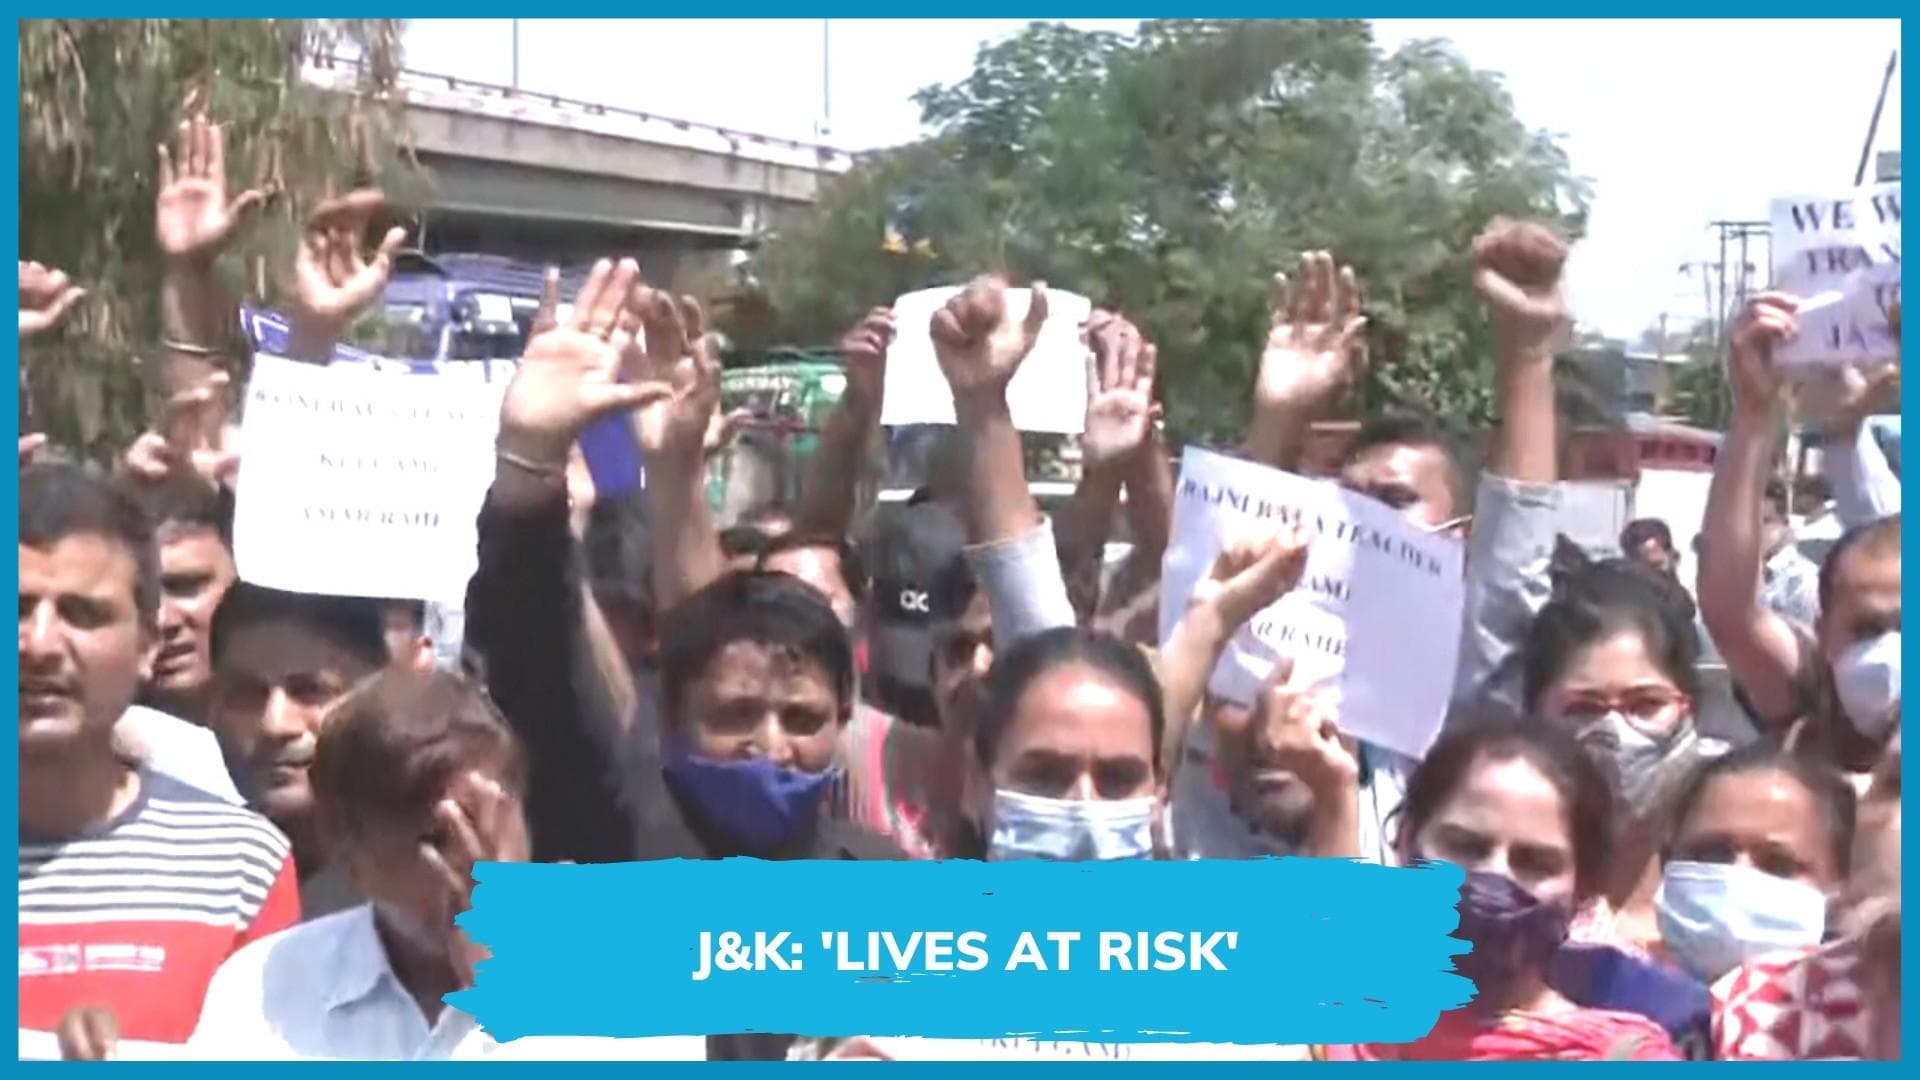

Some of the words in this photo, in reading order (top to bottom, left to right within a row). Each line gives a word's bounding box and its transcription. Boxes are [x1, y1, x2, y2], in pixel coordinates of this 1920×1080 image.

[1791, 200, 1855, 233] WE
[1180, 478, 1251, 513] RAJNI
[1334, 519, 1442, 577] TEACHER
